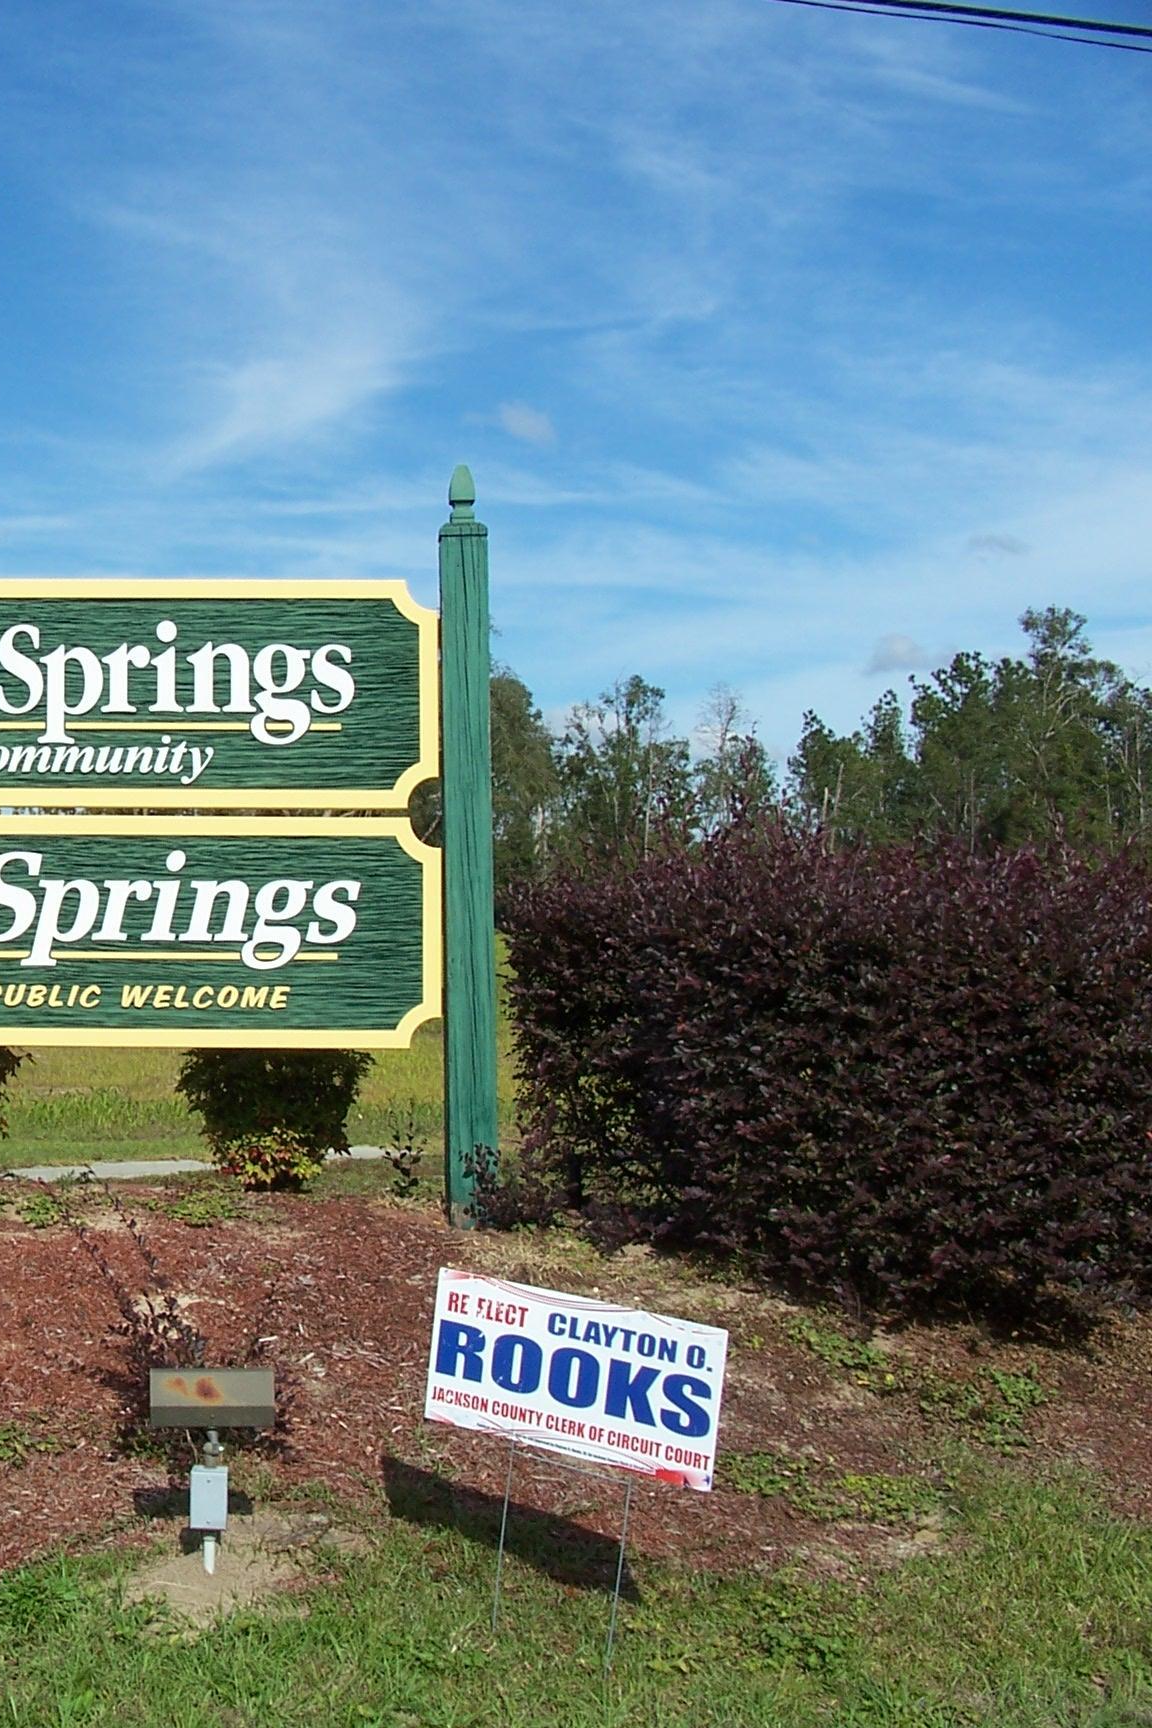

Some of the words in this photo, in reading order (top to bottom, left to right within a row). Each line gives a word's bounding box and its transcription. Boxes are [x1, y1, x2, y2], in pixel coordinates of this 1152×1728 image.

[120, 985, 291, 1010] WELCOME
[435, 1319, 713, 1438] ROOKS
[547, 1312, 678, 1364] CLAYTON
[686, 1345, 713, 1372] O.
[431, 1386, 489, 1414] JACKSON
[491, 1399, 543, 1427] COUNTY
[545, 1414, 586, 1438] CLERK
[588, 1428, 606, 1444] OF
[607, 1431, 663, 1459] CIRCUIT
[664, 1446, 711, 1472] COURT
